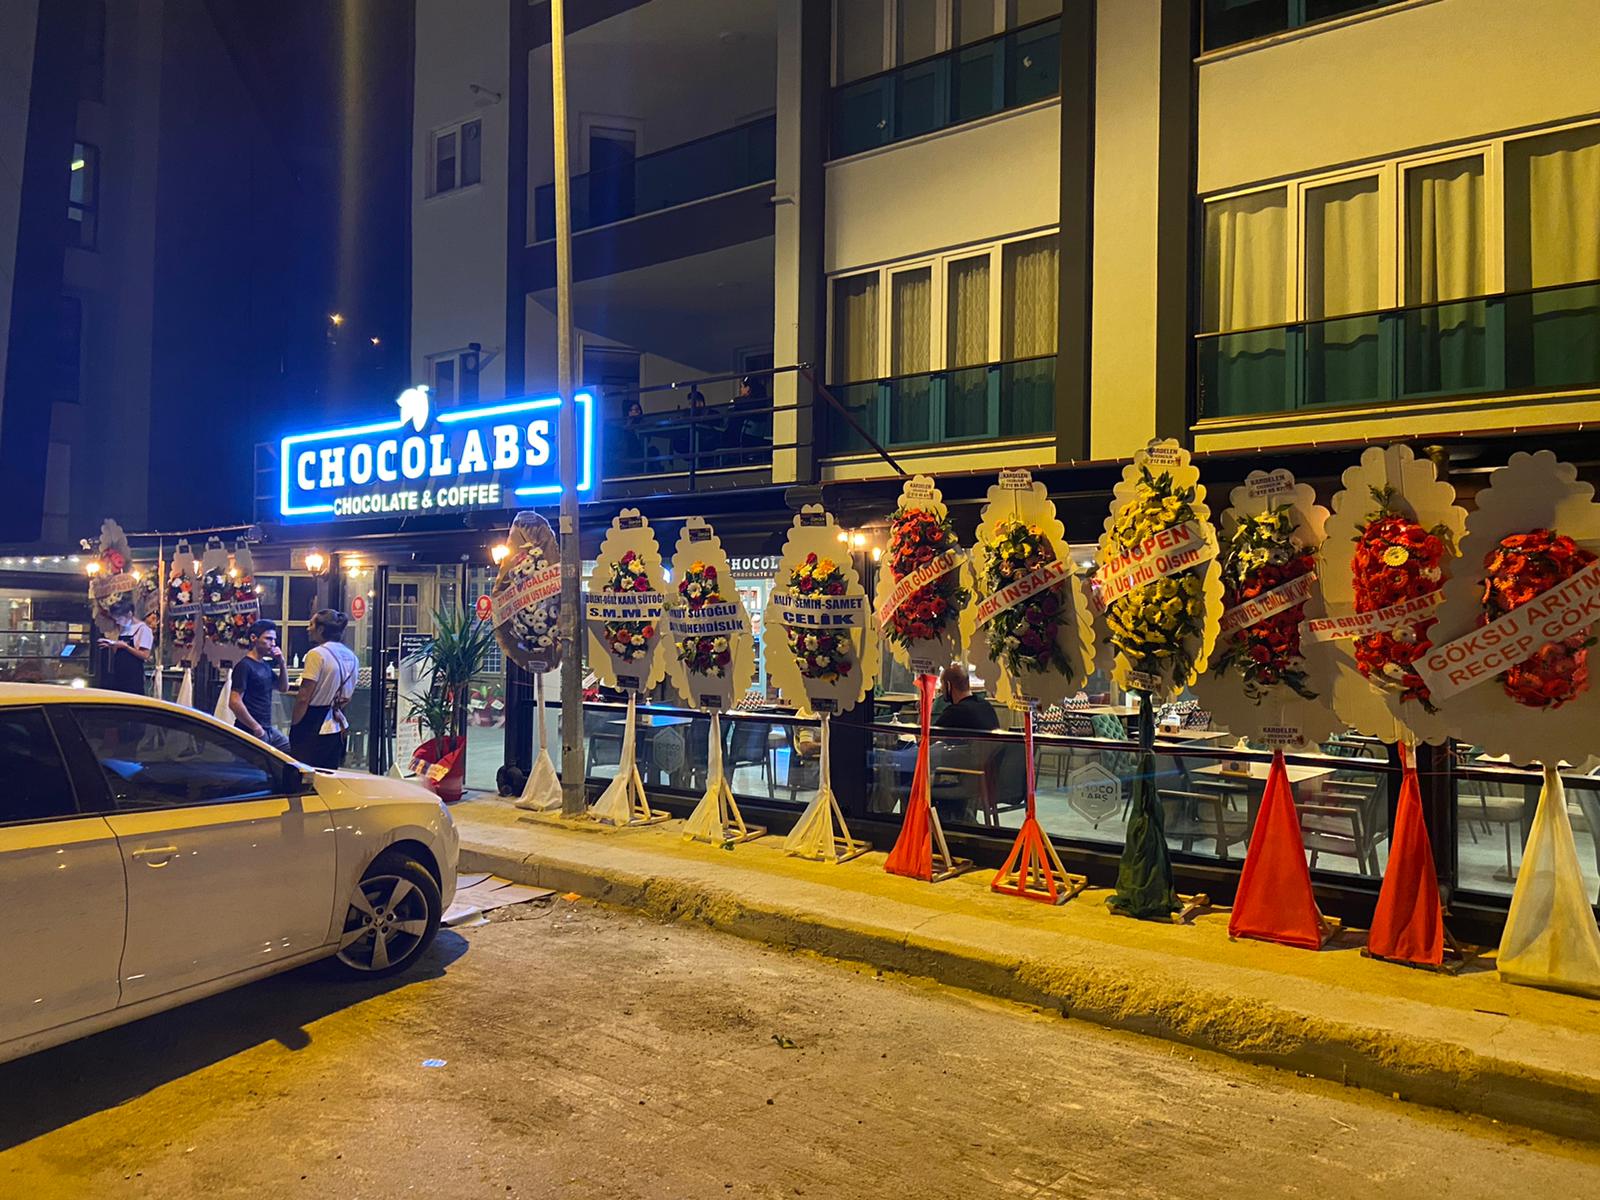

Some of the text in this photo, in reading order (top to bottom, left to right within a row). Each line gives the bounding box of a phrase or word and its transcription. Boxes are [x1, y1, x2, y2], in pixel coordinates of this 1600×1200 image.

[297, 420, 550, 490] CHOCOLABS
[333, 484, 500, 516] CHOCOLATE & COFFEE
[726, 556, 778, 570] HOCOL
[1156, 549, 1199, 574] Olsun
[1309, 620, 1336, 633] ASA
[1338, 612, 1374, 628] GRUP
[1427, 619, 1519, 672] GÖKSU
[1448, 592, 1600, 686] RECEP GÖK
